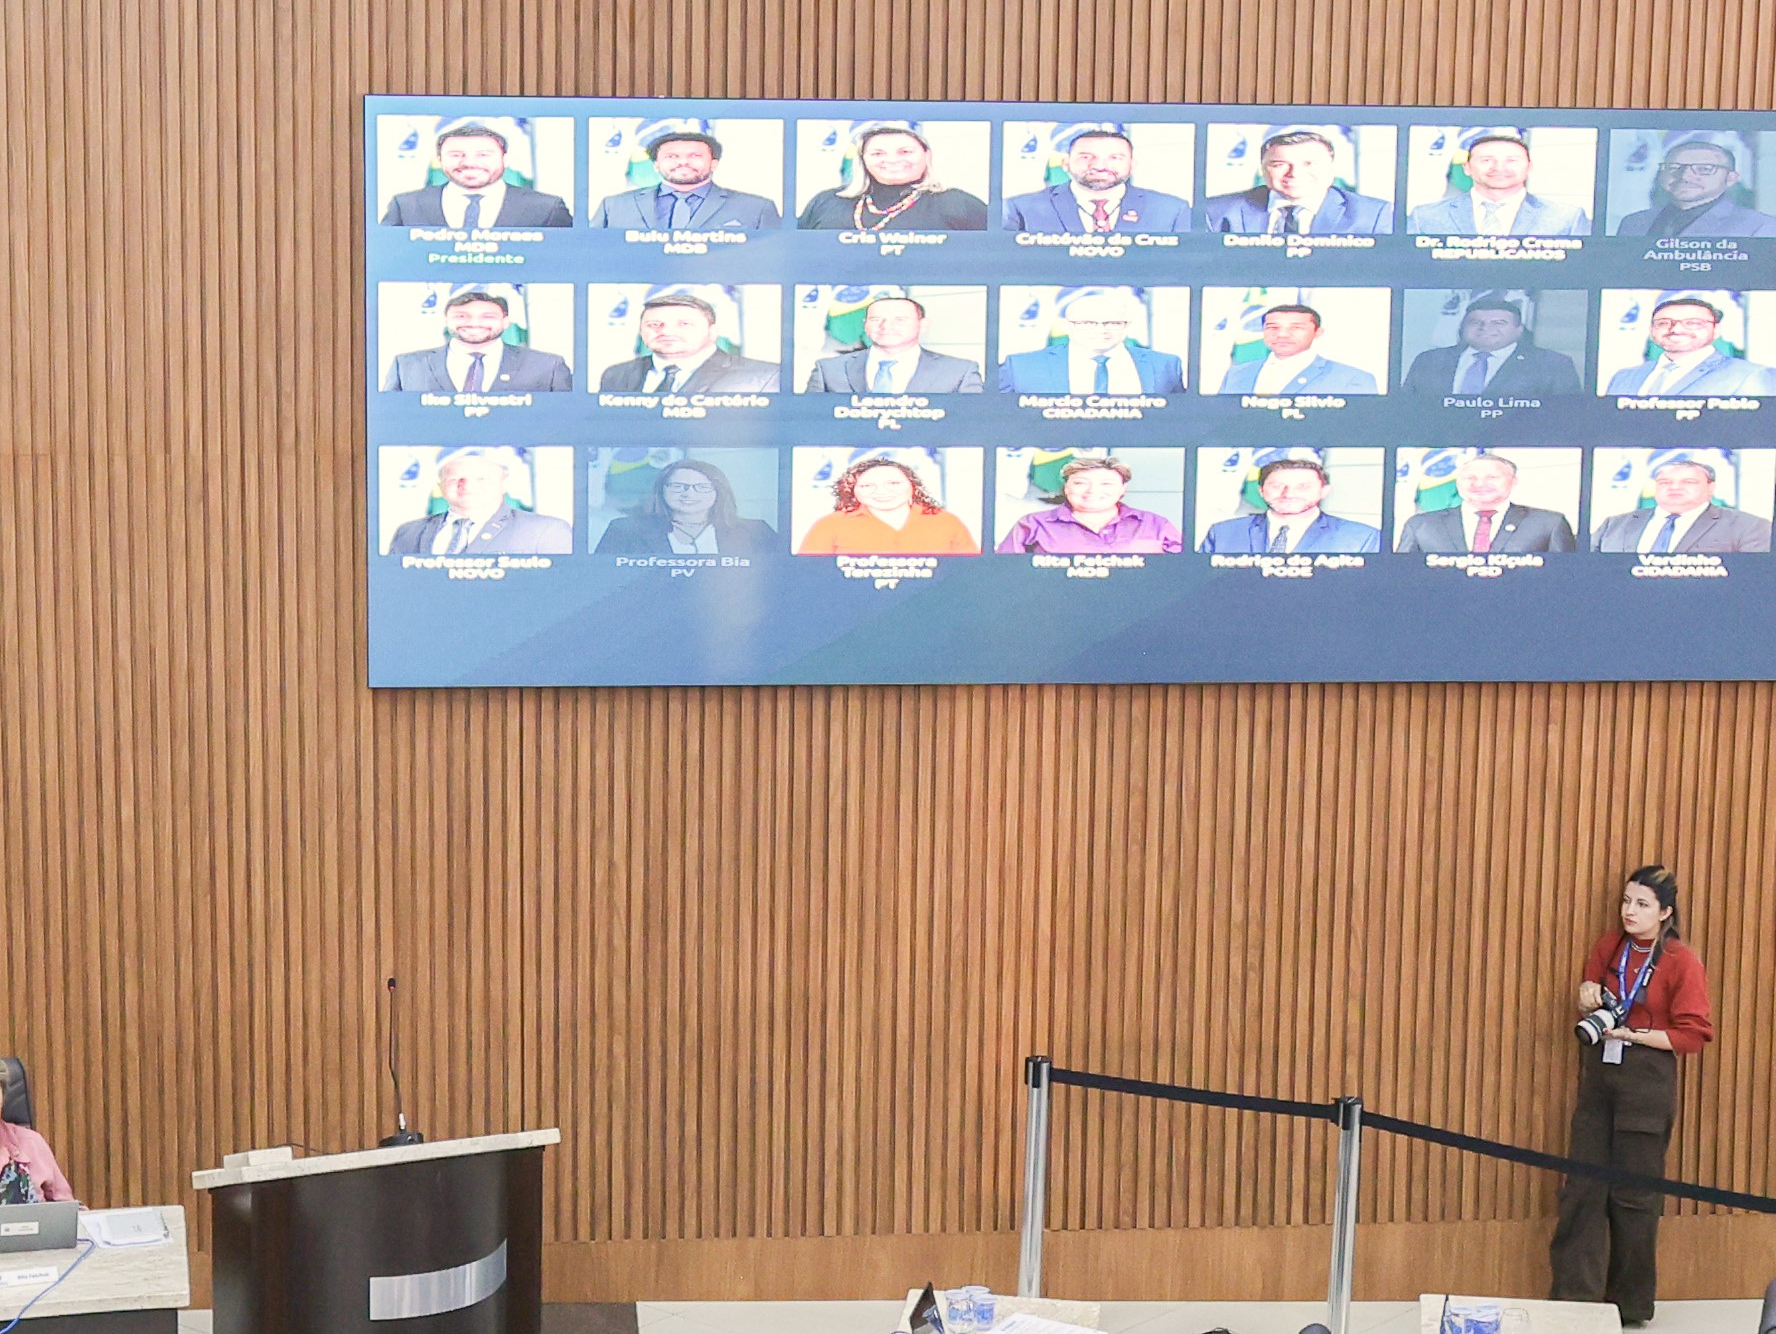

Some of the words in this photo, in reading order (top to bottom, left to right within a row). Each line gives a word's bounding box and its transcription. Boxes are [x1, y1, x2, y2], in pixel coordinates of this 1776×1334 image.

[409, 229, 464, 242] Pedro
[467, 230, 544, 243] Moraes
[673, 231, 748, 244] Martins
[838, 232, 876, 244] Cris
[1015, 232, 1104, 246] Cristóvão
[1135, 234, 1179, 246] Cruz
[1223, 234, 1285, 247] Danilo
[1287, 235, 1375, 248] Dominico
[454, 242, 499, 253] MDB
[664, 243, 708, 254] MDB
[1416, 237, 1443, 248] Dr.
[1446, 236, 1519, 251] Rodrigo
[1656, 238, 1712, 250] Gilson
[1716, 238, 1738, 250] da
[880, 245, 905, 256] PT
[1069, 246, 1125, 257] NOVO
[1286, 247, 1312, 259] PP
[1431, 248, 1567, 261] REPUBLICANOS
[1643, 249, 1749, 261] Ambulância
[428, 253, 525, 264] Presidente
[1680, 262, 1712, 272] PSB
[456, 393, 532, 407] Silvestri
[599, 394, 659, 410] Kenny
[662, 394, 684, 407] do
[686, 394, 769, 408] Cartório
[851, 395, 930, 408] Leandro
[1086, 395, 1167, 409] Carneiro
[1241, 396, 1292, 410] Nego
[1294, 395, 1346, 409] Silvio
[1444, 397, 1494, 409] Paulo
[1499, 397, 1541, 409] Lima
[1617, 397, 1705, 410] Professor
[1707, 397, 1760, 410] Pablo
[464, 406, 490, 418] PP
[663, 407, 707, 419] MDB
[833, 406, 945, 421] Dobrychtop
[1042, 407, 1143, 419] CIDADANIA
[1282, 408, 1306, 420] PL
[1481, 410, 1504, 419] PP
[1675, 409, 1701, 421] PP
[878, 418, 902, 430] PL
[401, 556, 495, 569] Professor
[497, 556, 552, 569] Saulo
[616, 557, 718, 568] Professora
[722, 557, 751, 568] Bia
[837, 555, 938, 569] Professora
[1032, 555, 1071, 568] Rita
[1074, 555, 1145, 568] Felchak
[1210, 555, 1284, 570] Rodrigo
[1286, 555, 1312, 568] do
[1313, 555, 1365, 569] Agita
[1639, 554, 1722, 567] Verdinho
[448, 568, 505, 580] NOVO
[671, 568, 695, 578] PV
[841, 567, 933, 580] Terezinha
[1067, 567, 1110, 579] MDB
[1262, 567, 1313, 579] PODE
[1466, 566, 1503, 578] PSD
[1630, 566, 1729, 578] CIDADANIA
[874, 578, 900, 590] PT
